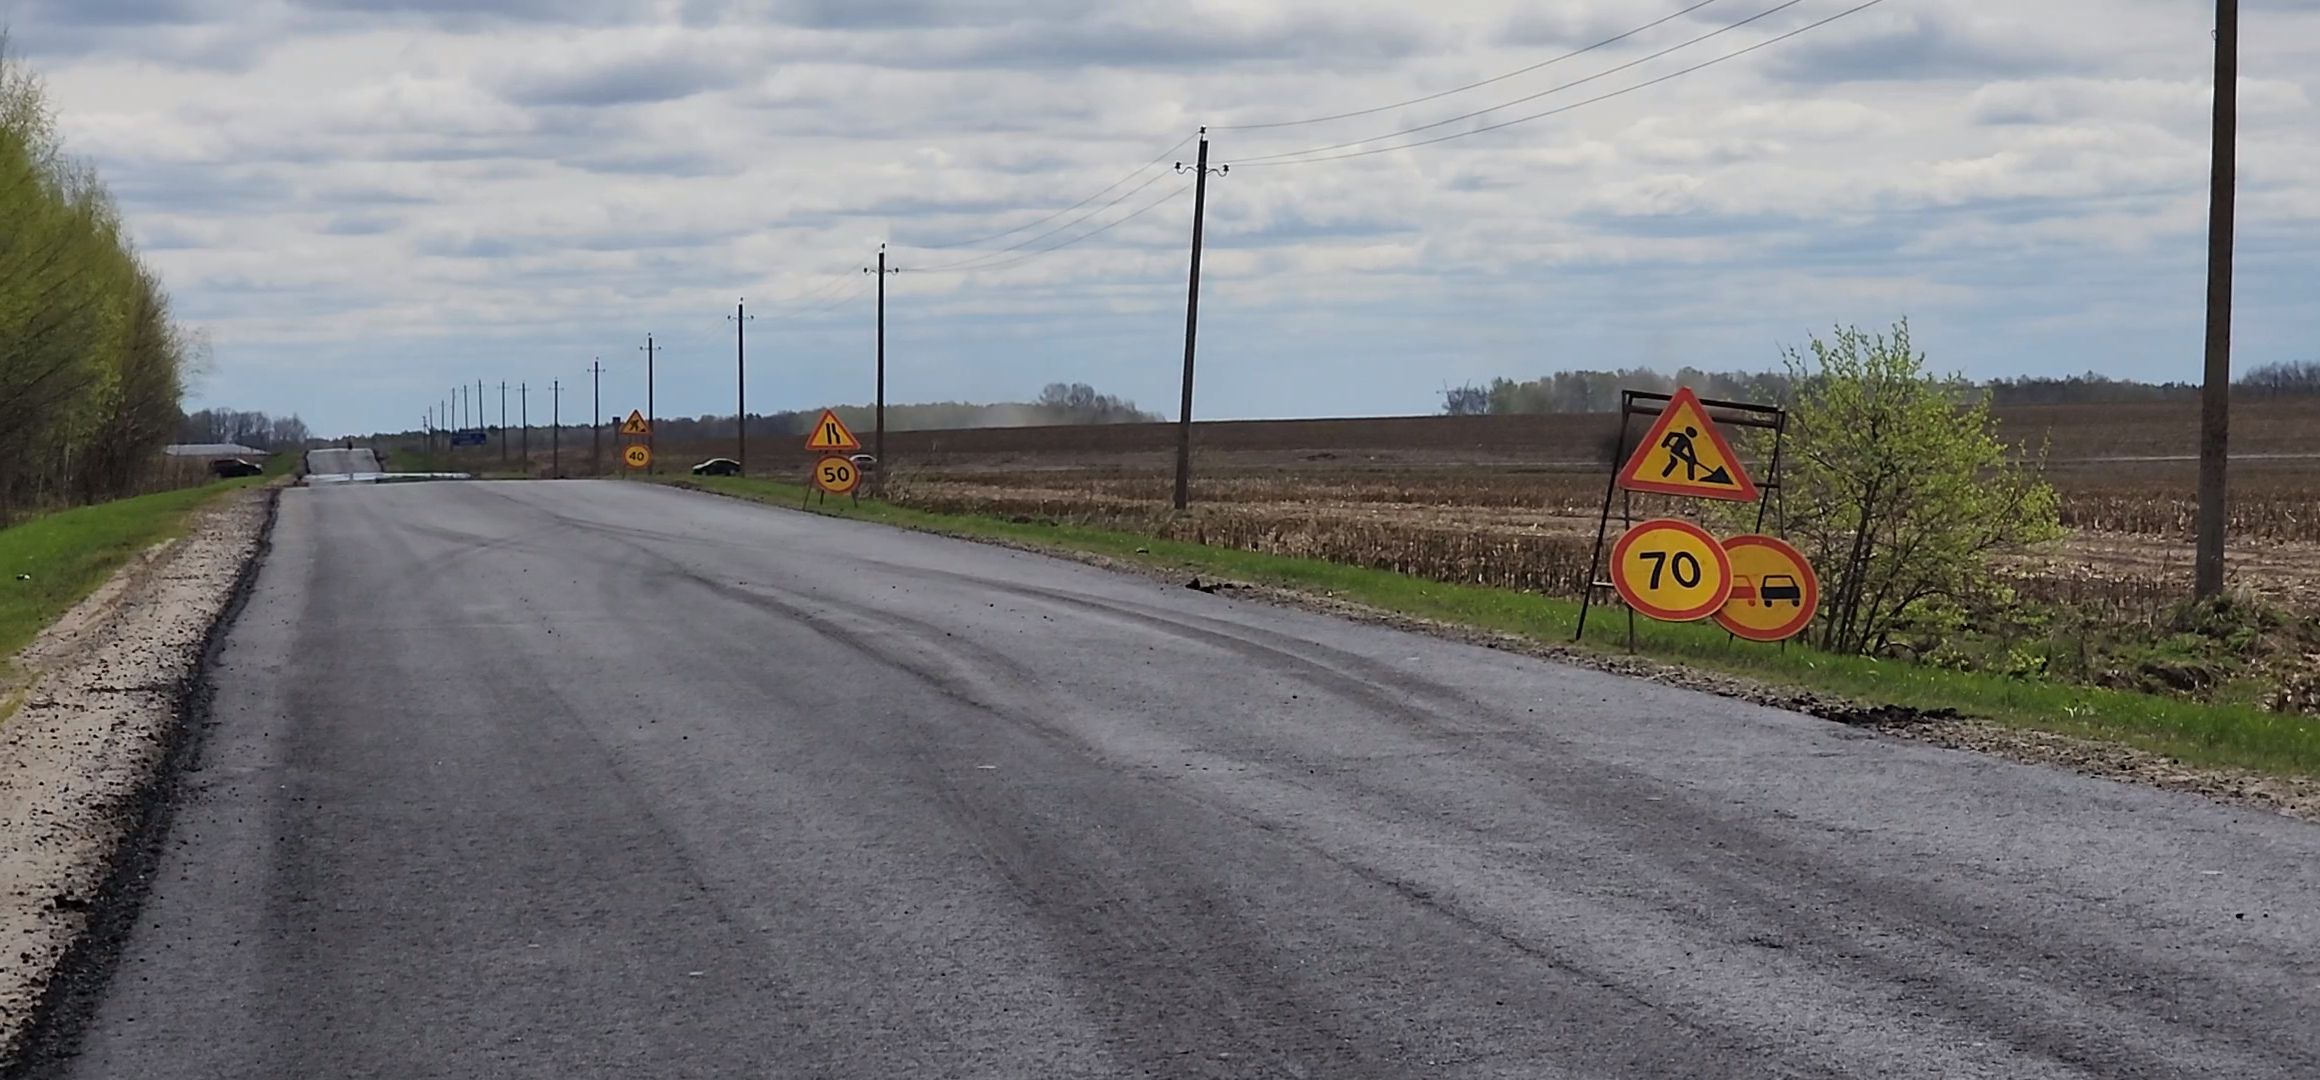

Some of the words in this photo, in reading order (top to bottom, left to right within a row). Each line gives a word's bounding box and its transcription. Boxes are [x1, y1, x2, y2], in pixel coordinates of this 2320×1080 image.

[629, 451, 645, 461] 40
[823, 466, 850, 483] 50
[1639, 551, 1701, 590] 70
